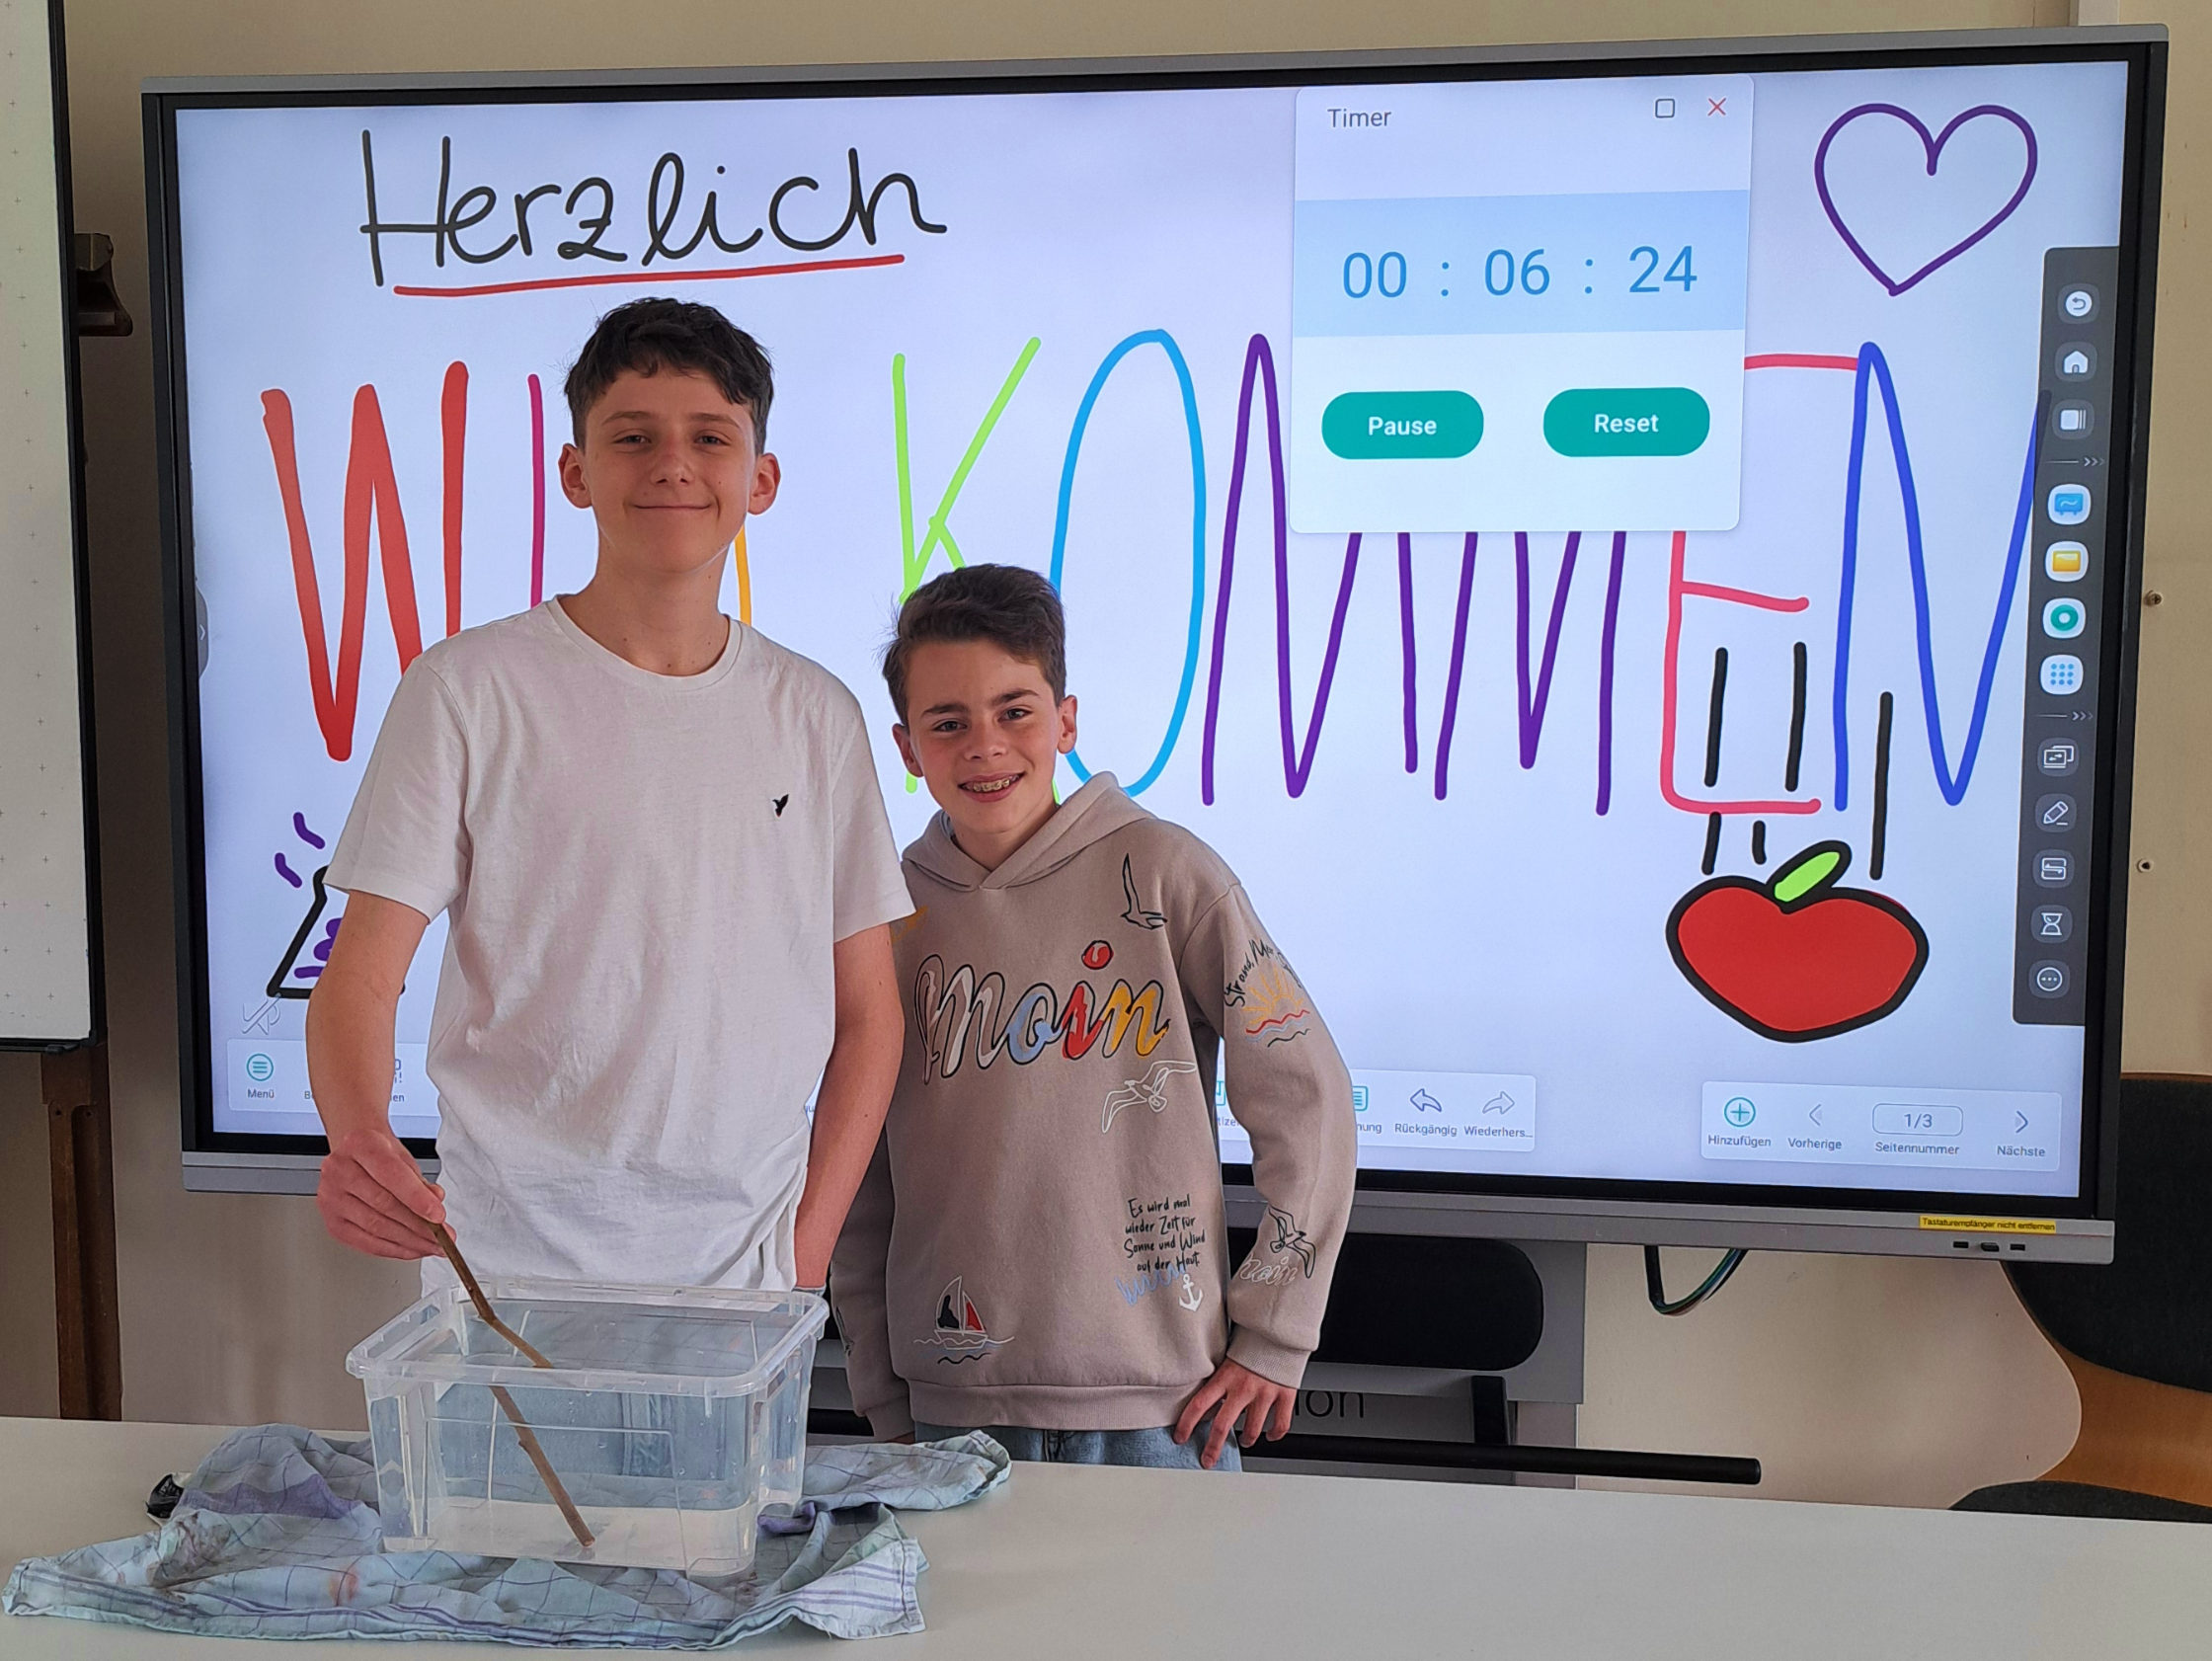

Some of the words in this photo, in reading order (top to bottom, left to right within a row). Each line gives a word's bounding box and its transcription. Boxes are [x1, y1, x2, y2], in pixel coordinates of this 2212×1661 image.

[1327, 107, 1392, 129] Timer
[359, 129, 948, 287] Herzlich
[1368, 416, 1438, 436] Pause
[1594, 413, 1659, 435] Reset
[247, 1088, 275, 1099] Menü
[1394, 1122, 1458, 1137] Rückgängig
[1904, 1113, 1933, 1129] 1/3
[1707, 1134, 1772, 1148] Hinzufügen
[1787, 1137, 1843, 1151] Vorherige
[1875, 1142, 1960, 1155] Seitennummer
[1997, 1145, 2046, 1157] Nächste
[1128, 1198, 1144, 1218] Es
[1146, 1197, 1170, 1213] wird
[1173, 1193, 1190, 1210] mal
[1125, 1219, 1155, 1234] wieder
[1158, 1216, 1180, 1235] Zeit
[1182, 1217, 1196, 1230] für
[1124, 1238, 1154, 1258] Sonne
[1159, 1234, 1175, 1250] und
[1179, 1228, 1206, 1251] Wind
[1137, 1259, 1151, 1273] auf
[1154, 1256, 1171, 1270] der
